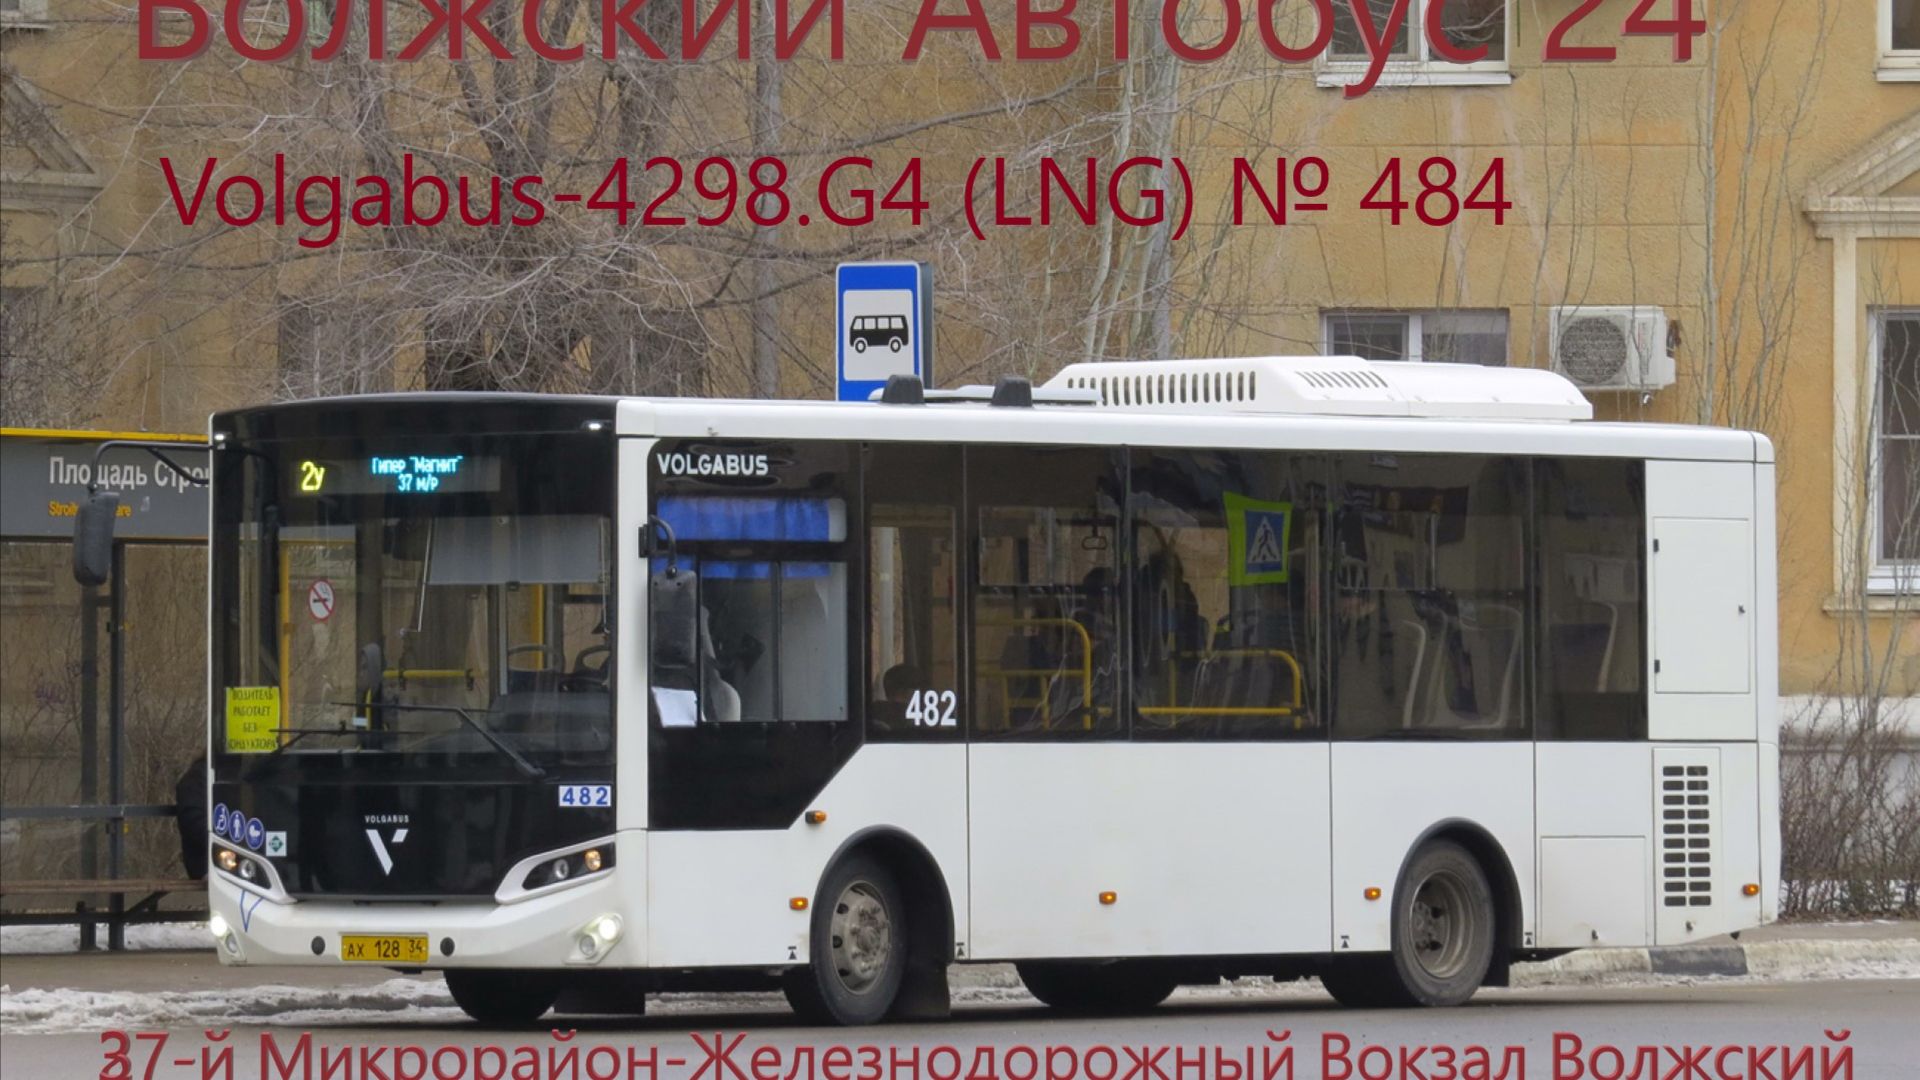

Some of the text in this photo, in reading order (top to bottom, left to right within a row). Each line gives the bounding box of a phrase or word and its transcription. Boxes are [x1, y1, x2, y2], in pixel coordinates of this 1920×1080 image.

[656, 452, 769, 475] VOLGABUS
[398, 473, 413, 491] 37
[904, 689, 957, 727] 482
[562, 786, 608, 806] 482
[364, 814, 409, 824] VOLGABUS
[374, 939, 401, 959] 128
